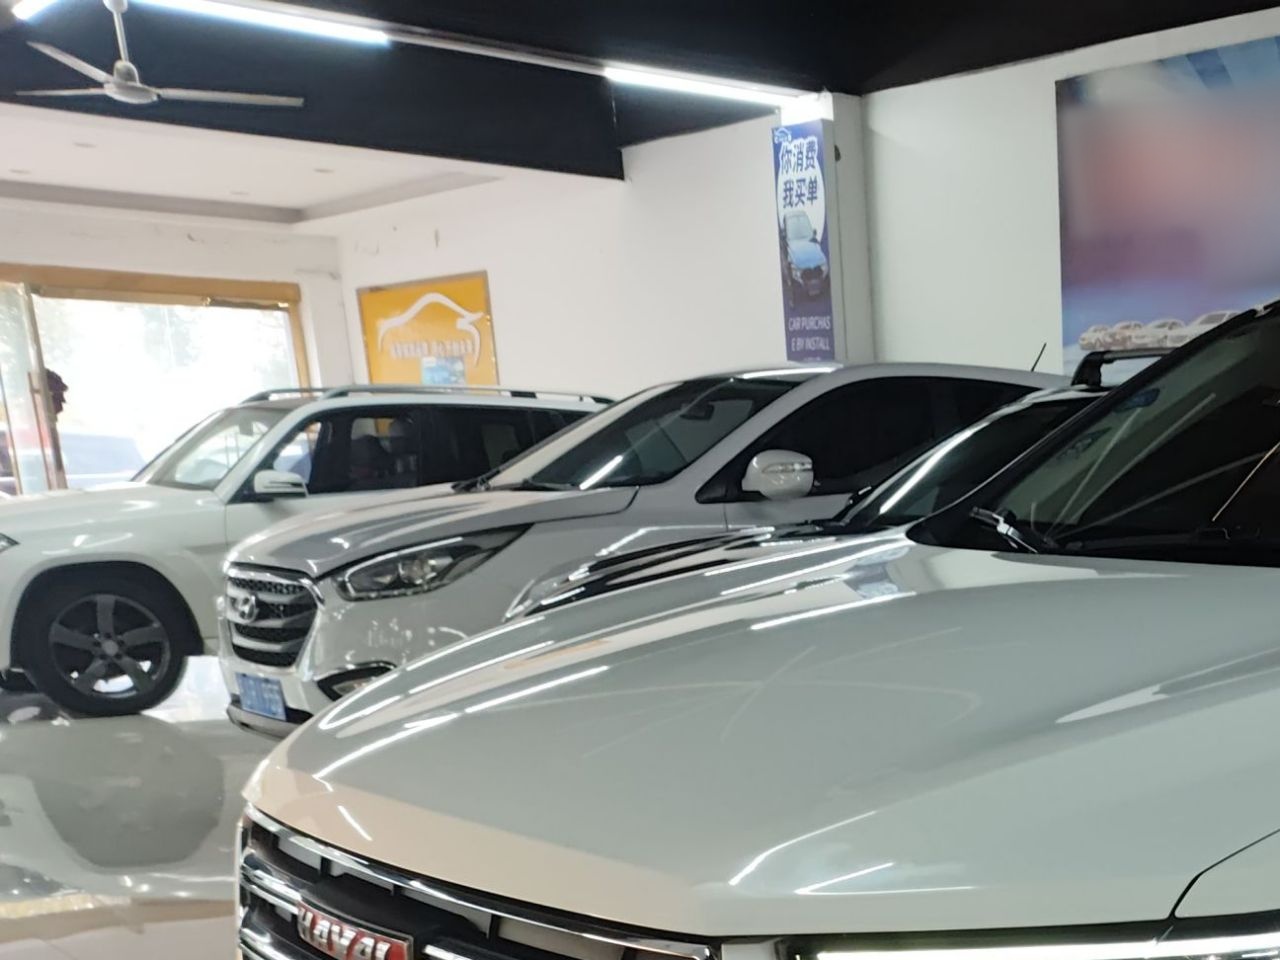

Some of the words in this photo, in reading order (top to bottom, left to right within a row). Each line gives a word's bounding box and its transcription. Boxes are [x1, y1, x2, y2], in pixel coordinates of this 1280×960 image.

[780, 139, 817, 174] 你消费
[782, 176, 818, 208] 我买单
